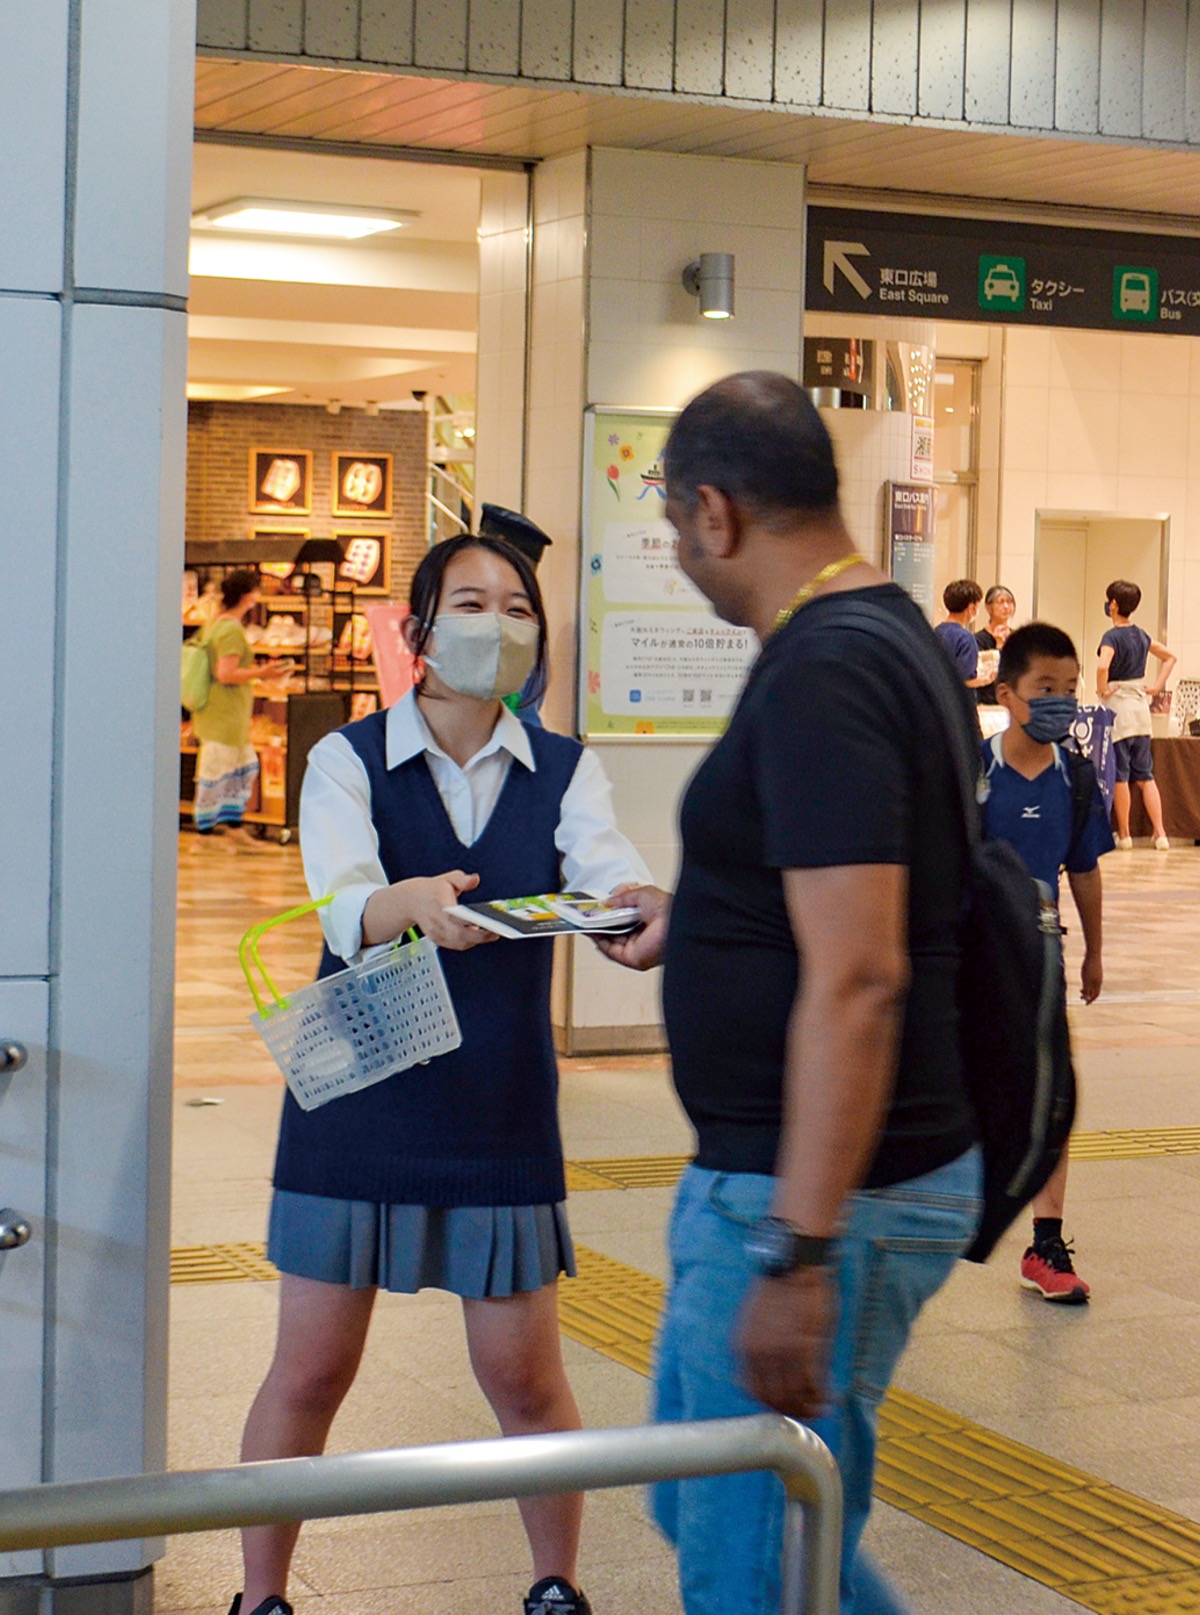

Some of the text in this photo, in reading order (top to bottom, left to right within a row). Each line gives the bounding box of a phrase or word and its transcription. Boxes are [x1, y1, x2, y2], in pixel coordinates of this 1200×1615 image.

[880, 267, 938, 288] 東口広場
[879, 287, 949, 304] East Square
[1031, 279, 1085, 297] タクシー
[1029, 298, 1053, 311] Taxi
[1160, 307, 1182, 320] Bus
